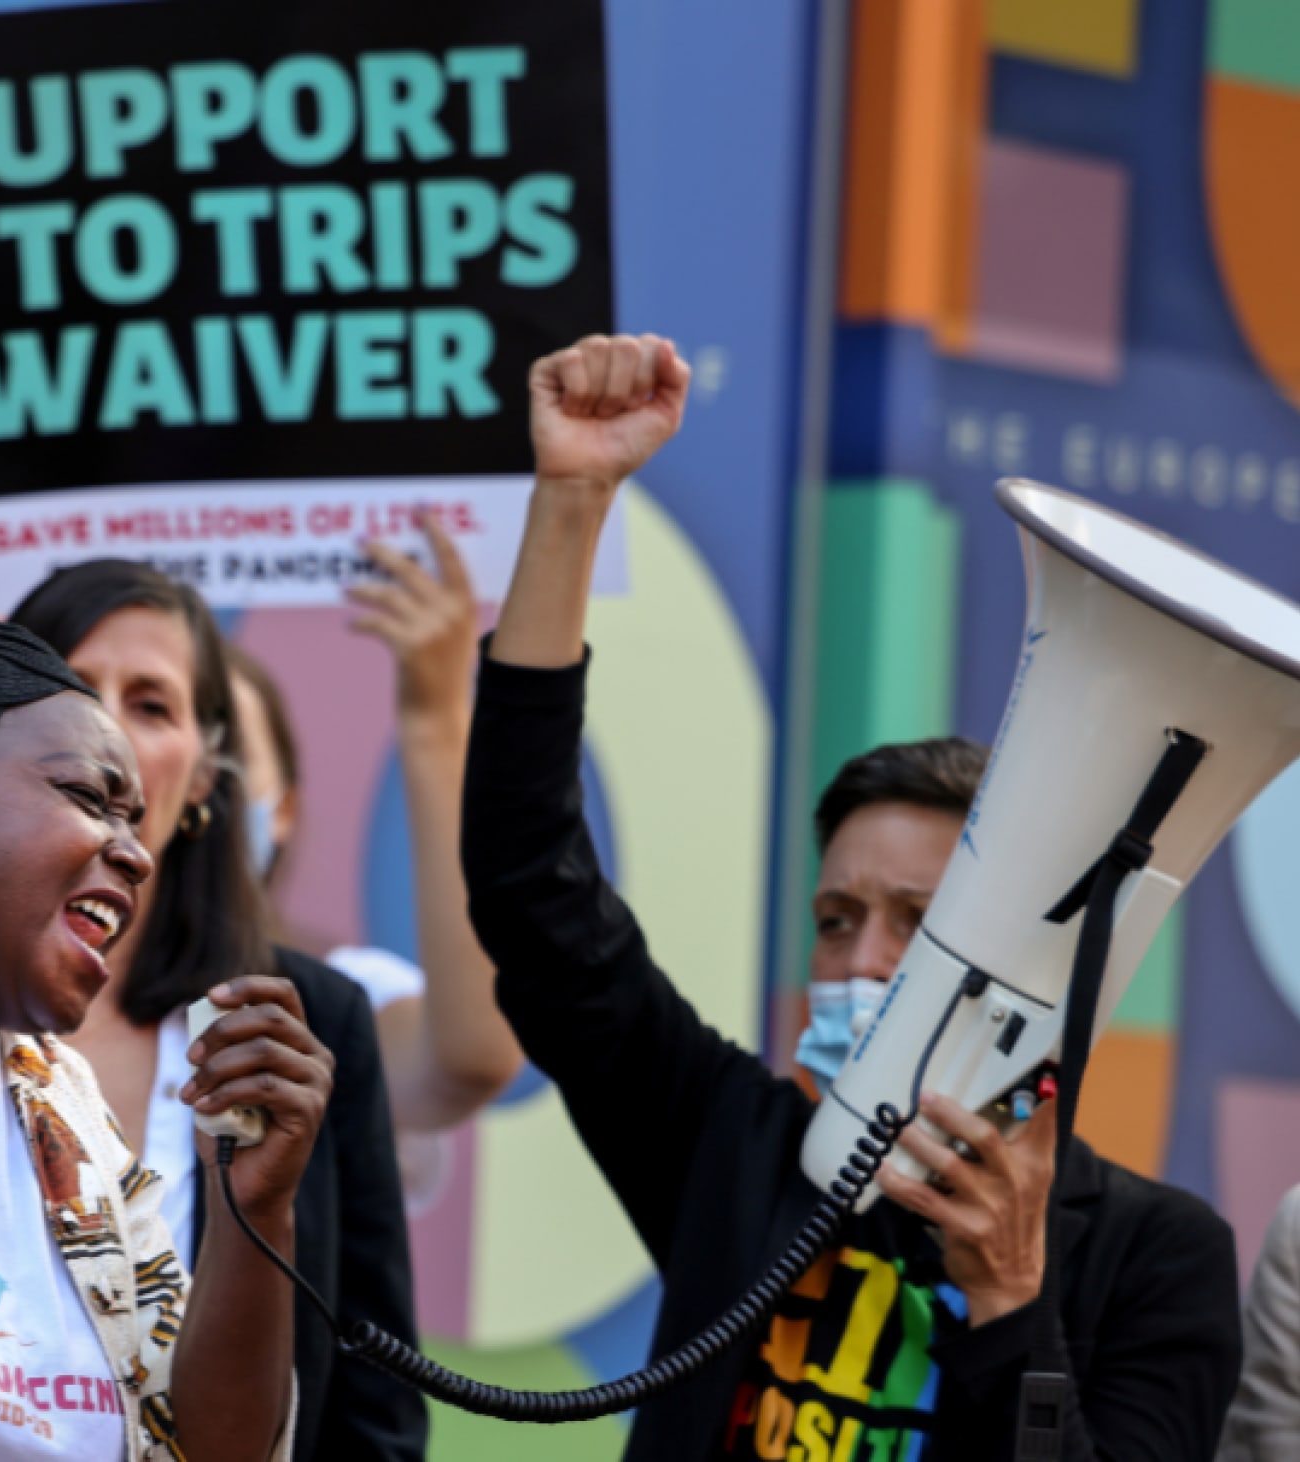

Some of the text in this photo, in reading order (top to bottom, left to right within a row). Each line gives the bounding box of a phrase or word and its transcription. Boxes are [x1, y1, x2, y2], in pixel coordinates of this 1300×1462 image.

[192, 174, 579, 296] TRIPS
[105, 505, 296, 541] MILLIONS
[306, 504, 353, 537] OF
